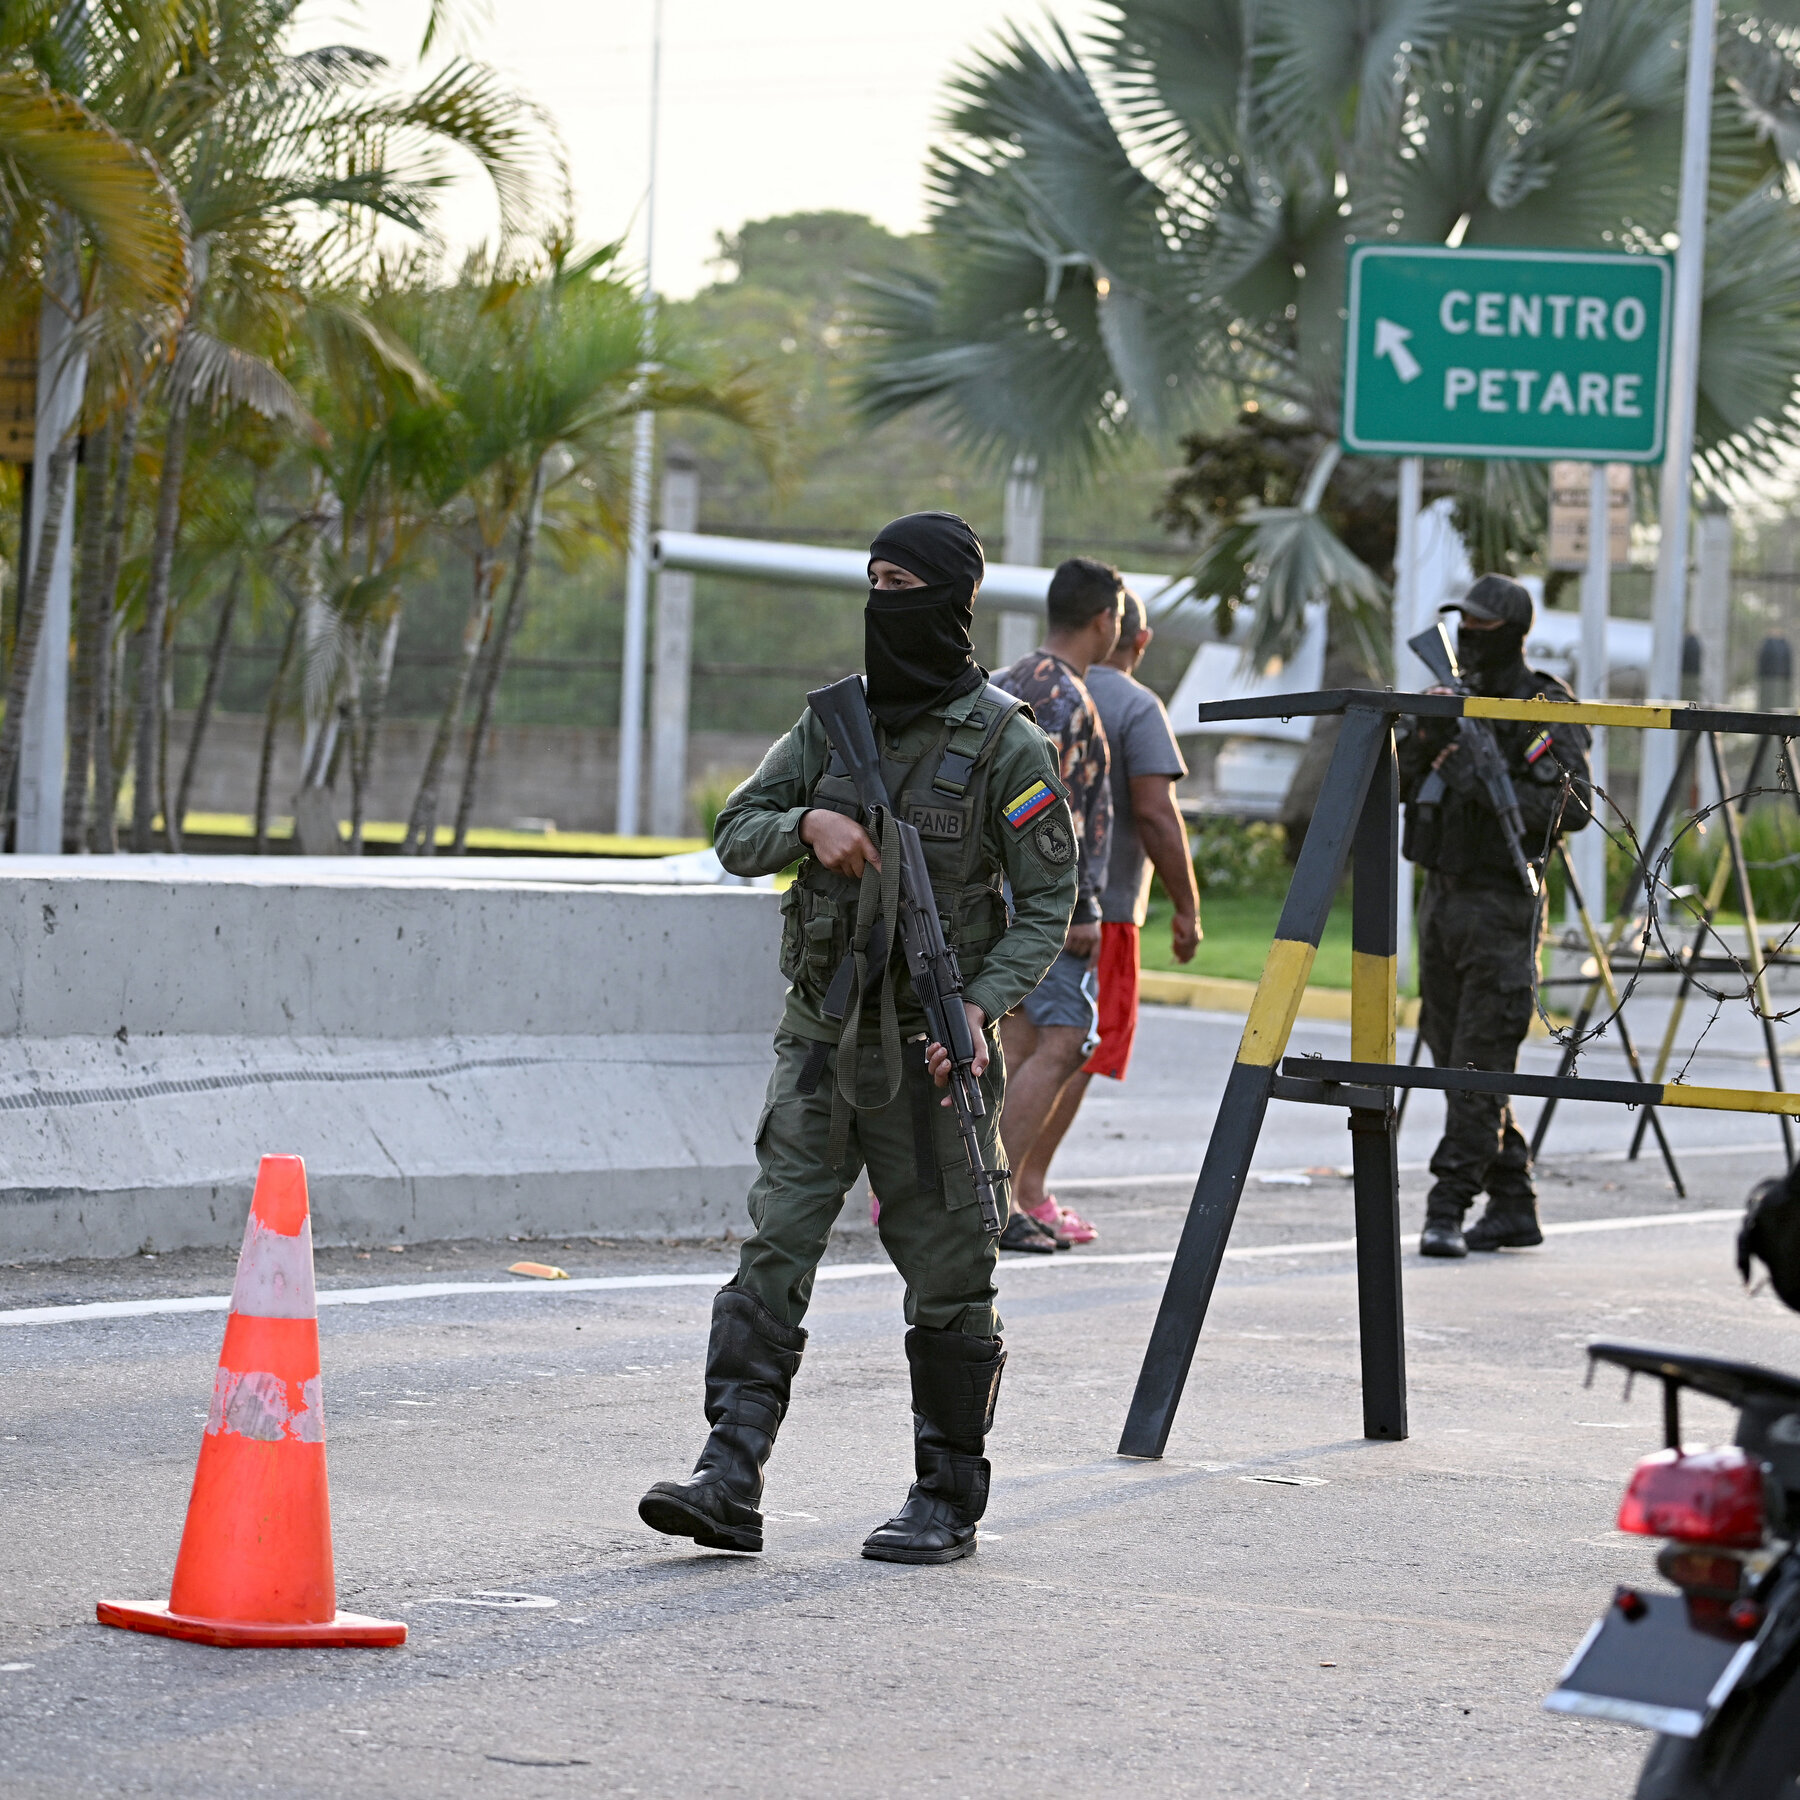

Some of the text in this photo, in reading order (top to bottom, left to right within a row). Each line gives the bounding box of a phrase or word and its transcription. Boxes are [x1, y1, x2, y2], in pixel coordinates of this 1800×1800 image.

[1439, 290, 1646, 341] CENTRO
[1443, 367, 1642, 417] PETARE
[912, 811, 959, 834] FANB
